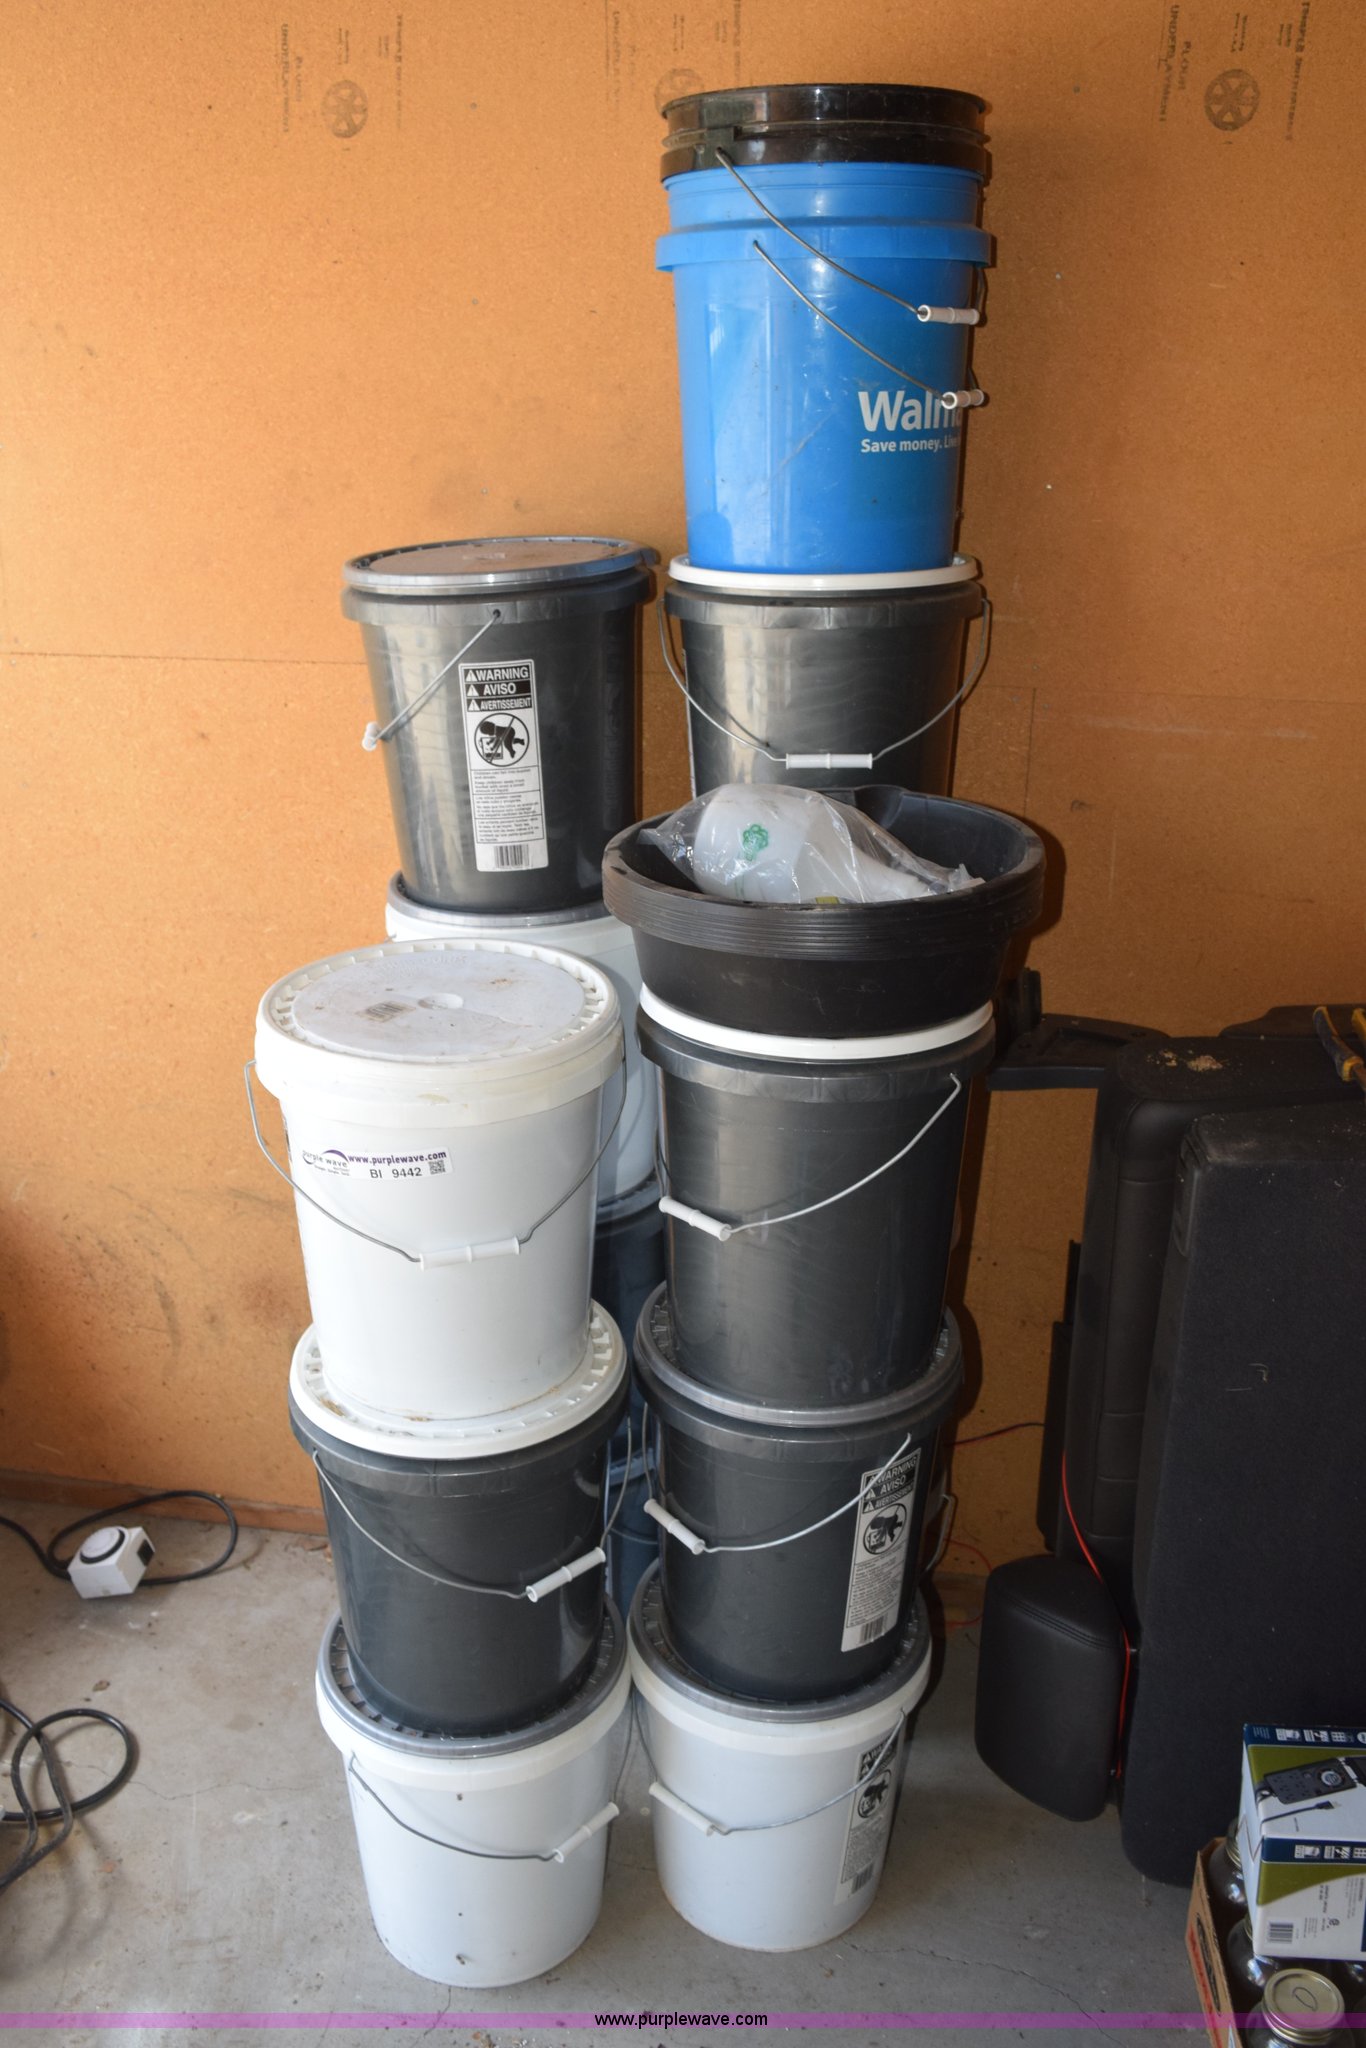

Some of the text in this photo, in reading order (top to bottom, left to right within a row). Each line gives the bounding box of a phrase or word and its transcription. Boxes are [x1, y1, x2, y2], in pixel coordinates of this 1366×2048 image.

[857, 390, 962, 432] Walm
[861, 438, 897, 453] Save
[899, 438, 942, 453] money.
[475, 666, 529, 682] WARNING
[483, 682, 517, 696] AVISO
[480, 697, 531, 710] AVERTISSEMENT
[325, 1158, 348, 1168] wave
[348, 1150, 447, 1166] www.purplewave.com
[391, 1166, 422, 1179] 9442
[880, 1474, 906, 1495] AVISO
